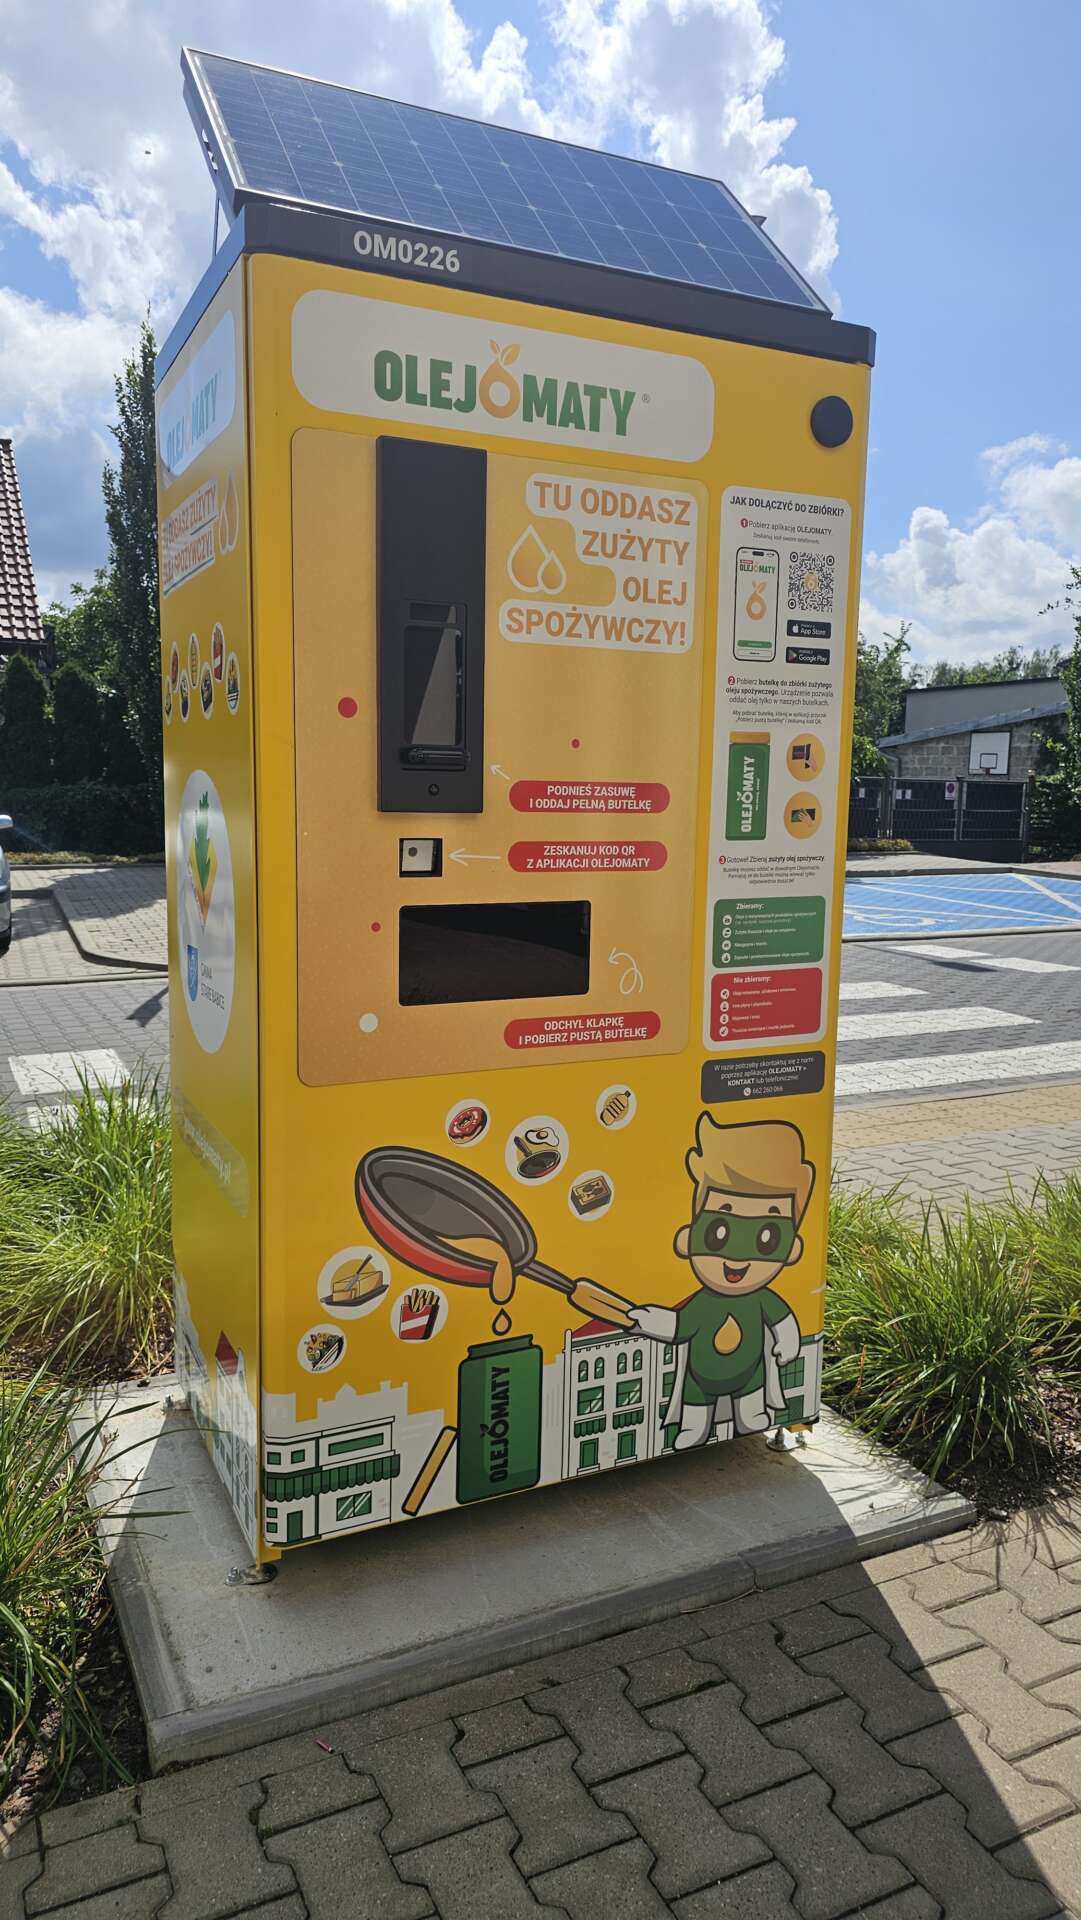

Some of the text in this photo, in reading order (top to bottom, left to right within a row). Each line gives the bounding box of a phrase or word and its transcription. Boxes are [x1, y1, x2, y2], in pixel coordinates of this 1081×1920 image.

[353, 230, 460, 273] OM0226
[374, 346, 636, 437] OLEJOMATY
[533, 480, 691, 526] TU ODDASZ
[730, 496, 845, 517] JAK DOŁĄCZYĆ DO ZBIÓRKI?
[749, 520, 770, 530] Pobierz
[797, 525, 832, 536] OLEJOMATY
[582, 528, 690, 566] ZUŻYTY
[622, 576, 688, 606] OLEJ
[506, 606, 686, 646] SPOŻYWCZY!
[800, 628, 826, 636] App Store
[799, 653, 828, 664] Google Play
[737, 677, 757, 685] Pobierz
[758, 678, 779, 688] butelkę
[726, 687, 740, 695] oleju
[547, 784, 637, 799] PODNIEŚ ZASUWĘ
[739, 756, 755, 832] OLEJOMATY
[529, 798, 533, 809] I
[536, 798, 570, 809] ODDAJ
[608, 800, 652, 812] BUTELKĘ
[544, 845, 636, 856] ZESKANUJ KOD QR
[527, 857, 650, 869] Z APLIKACJI OLEJOMATY
[733, 976, 743, 984] Nie
[544, 1016, 625, 1031] ODCHYL KLAPKĘ
[519, 1027, 648, 1045] I POBIERZ PUSTĄ BUTELKĘ
[714, 1064, 720, 1072] W
[768, 1065, 802, 1075] OLEJOMATY
[727, 1078, 755, 1087] KONTAKT
[486, 1366, 511, 1484] OLEJOMATY
